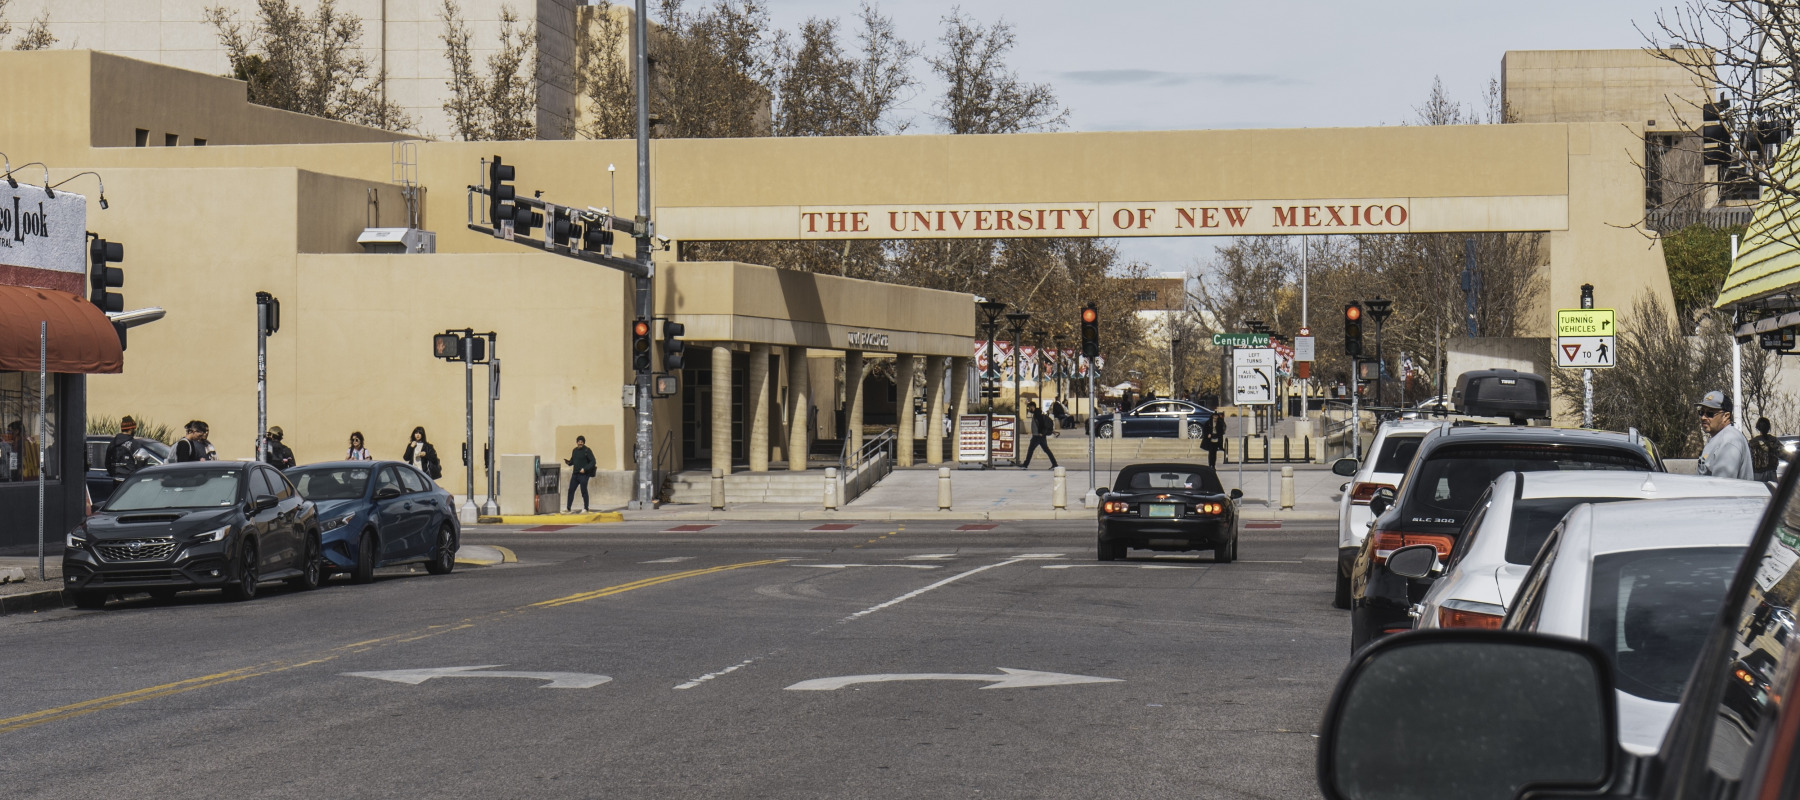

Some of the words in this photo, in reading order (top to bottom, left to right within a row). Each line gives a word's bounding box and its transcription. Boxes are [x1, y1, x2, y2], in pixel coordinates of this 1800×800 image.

[13, 196, 49, 246] Look
[802, 211, 870, 233] THE
[888, 208, 1095, 232] UNIVERSITY
[1112, 208, 1156, 230] OF
[1175, 206, 1252, 229] NEW
[1272, 204, 1408, 227] MEXICO
[1213, 334, 1249, 345] Central
[1252, 335, 1268, 344] Ave
